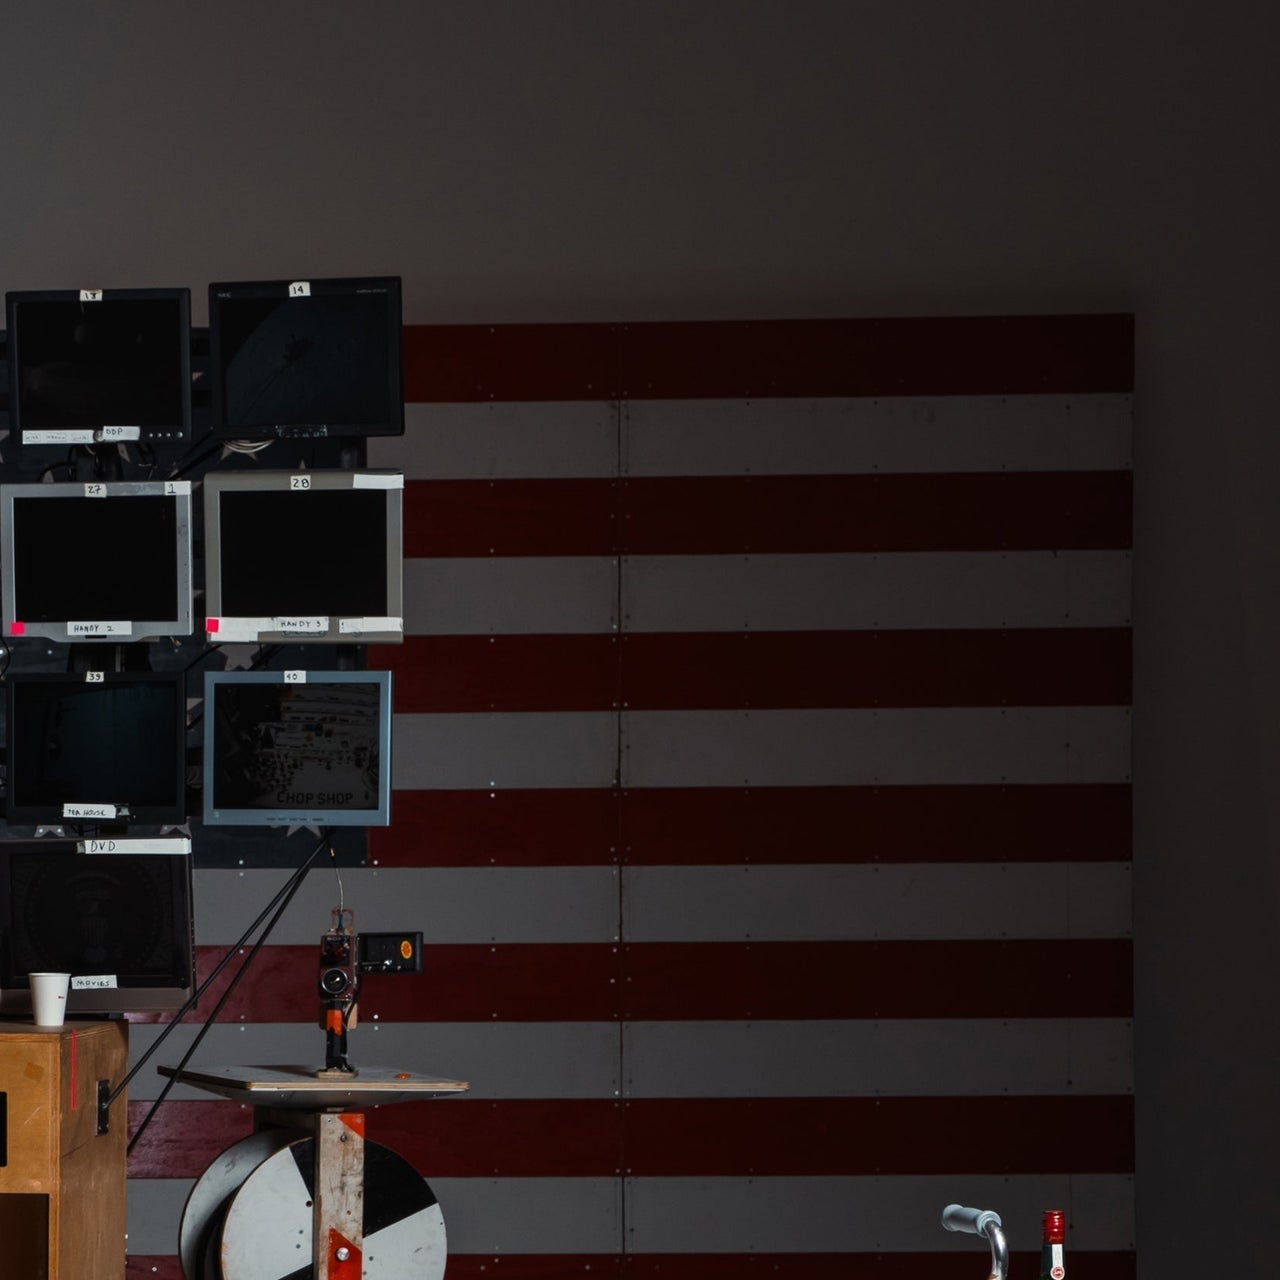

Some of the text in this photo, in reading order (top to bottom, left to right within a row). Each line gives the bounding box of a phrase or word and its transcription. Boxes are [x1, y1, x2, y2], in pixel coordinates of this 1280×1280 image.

[292, 286, 305, 296] 14
[293, 477, 308, 488] 28
[87, 486, 101, 494] 27
[74, 625, 98, 633] HANDY
[276, 790, 354, 805] CHOP SHOP
[90, 840, 115, 852] DVD
